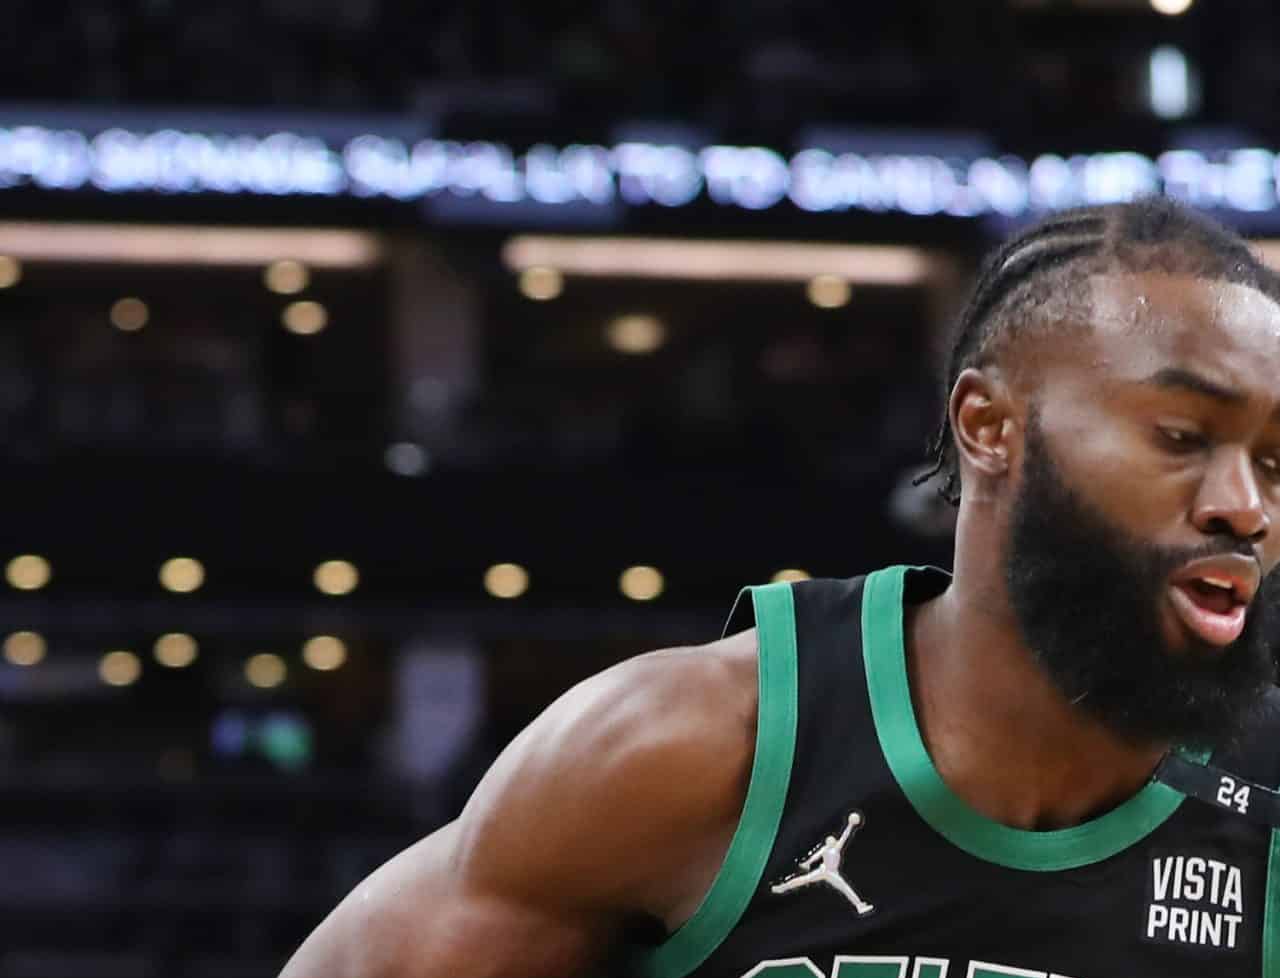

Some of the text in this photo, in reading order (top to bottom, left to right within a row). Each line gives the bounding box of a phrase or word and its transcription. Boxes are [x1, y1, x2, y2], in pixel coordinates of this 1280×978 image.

[1217, 775, 1250, 815] 24
[1153, 856, 1242, 913] VISTA
[1147, 903, 1242, 948] PRINT
